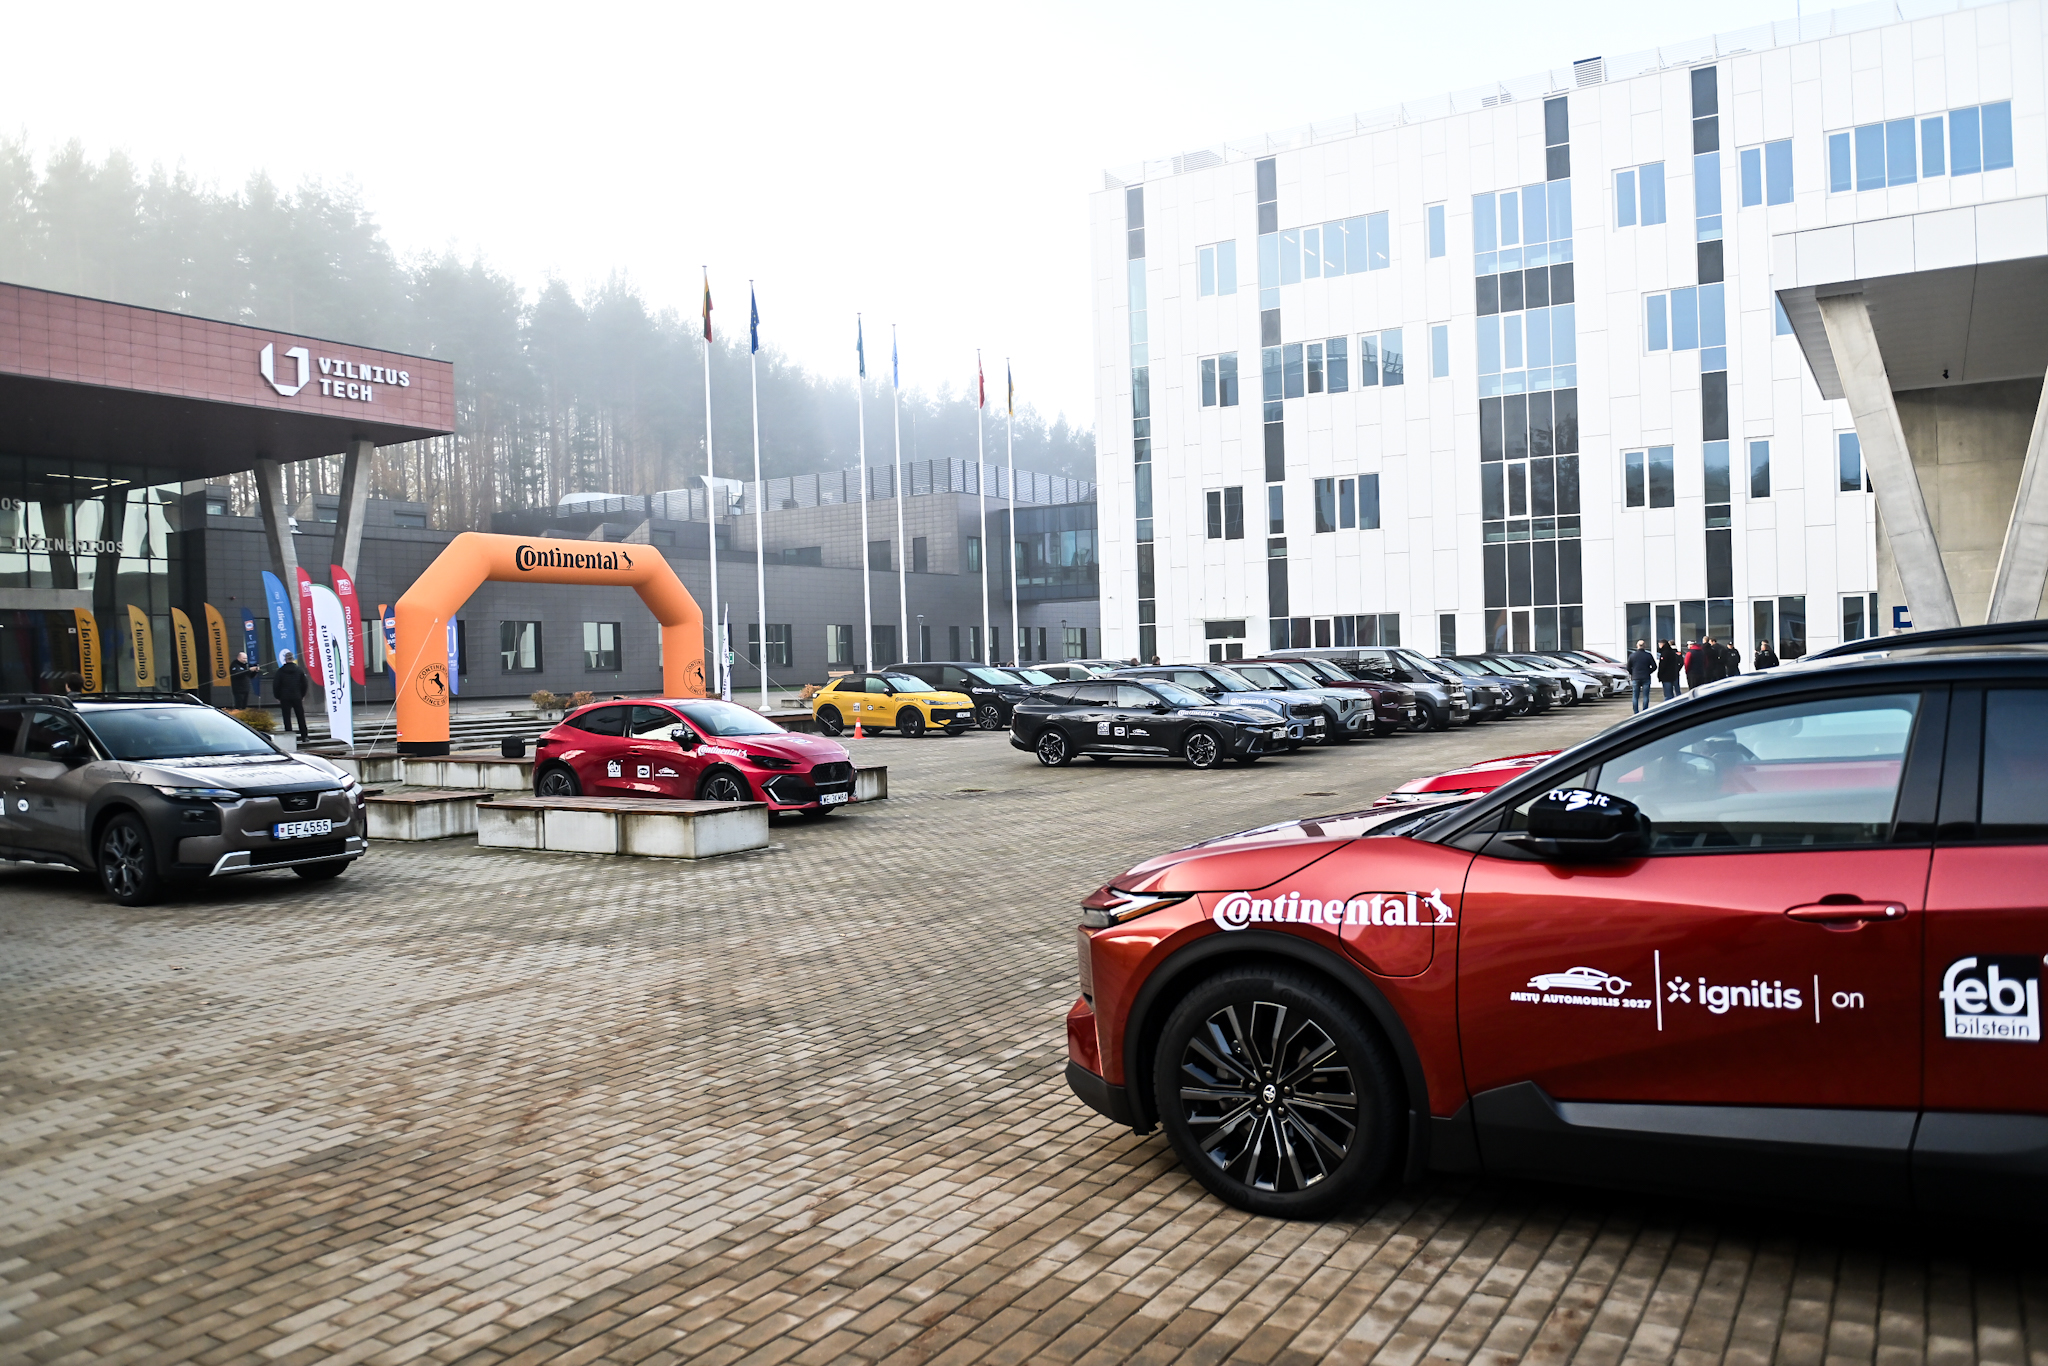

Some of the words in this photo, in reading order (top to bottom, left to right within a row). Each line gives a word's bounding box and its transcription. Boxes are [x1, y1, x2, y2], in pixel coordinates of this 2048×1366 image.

[318, 357, 410, 387] VILNIUS
[318, 378, 373, 402] TECH
[11, 534, 125, 553] INŽINERIJOS
[515, 544, 619, 572] Continental
[212, 626, 227, 680] Continental
[697, 744, 743, 757] Continental
[1548, 789, 1610, 811] tv3.lt
[286, 820, 330, 835] EF4555
[1212, 890, 1421, 932] Continental
[1698, 976, 1803, 1015] ignitis
[1831, 991, 1865, 1009] on
[1939, 956, 2040, 1017] febi
[1510, 992, 1541, 1005] METŲ
[1542, 994, 1621, 1007] AUTOMOBILIS
[1621, 998, 1652, 1009] 2027
[1955, 1017, 2030, 1036] bilstein
